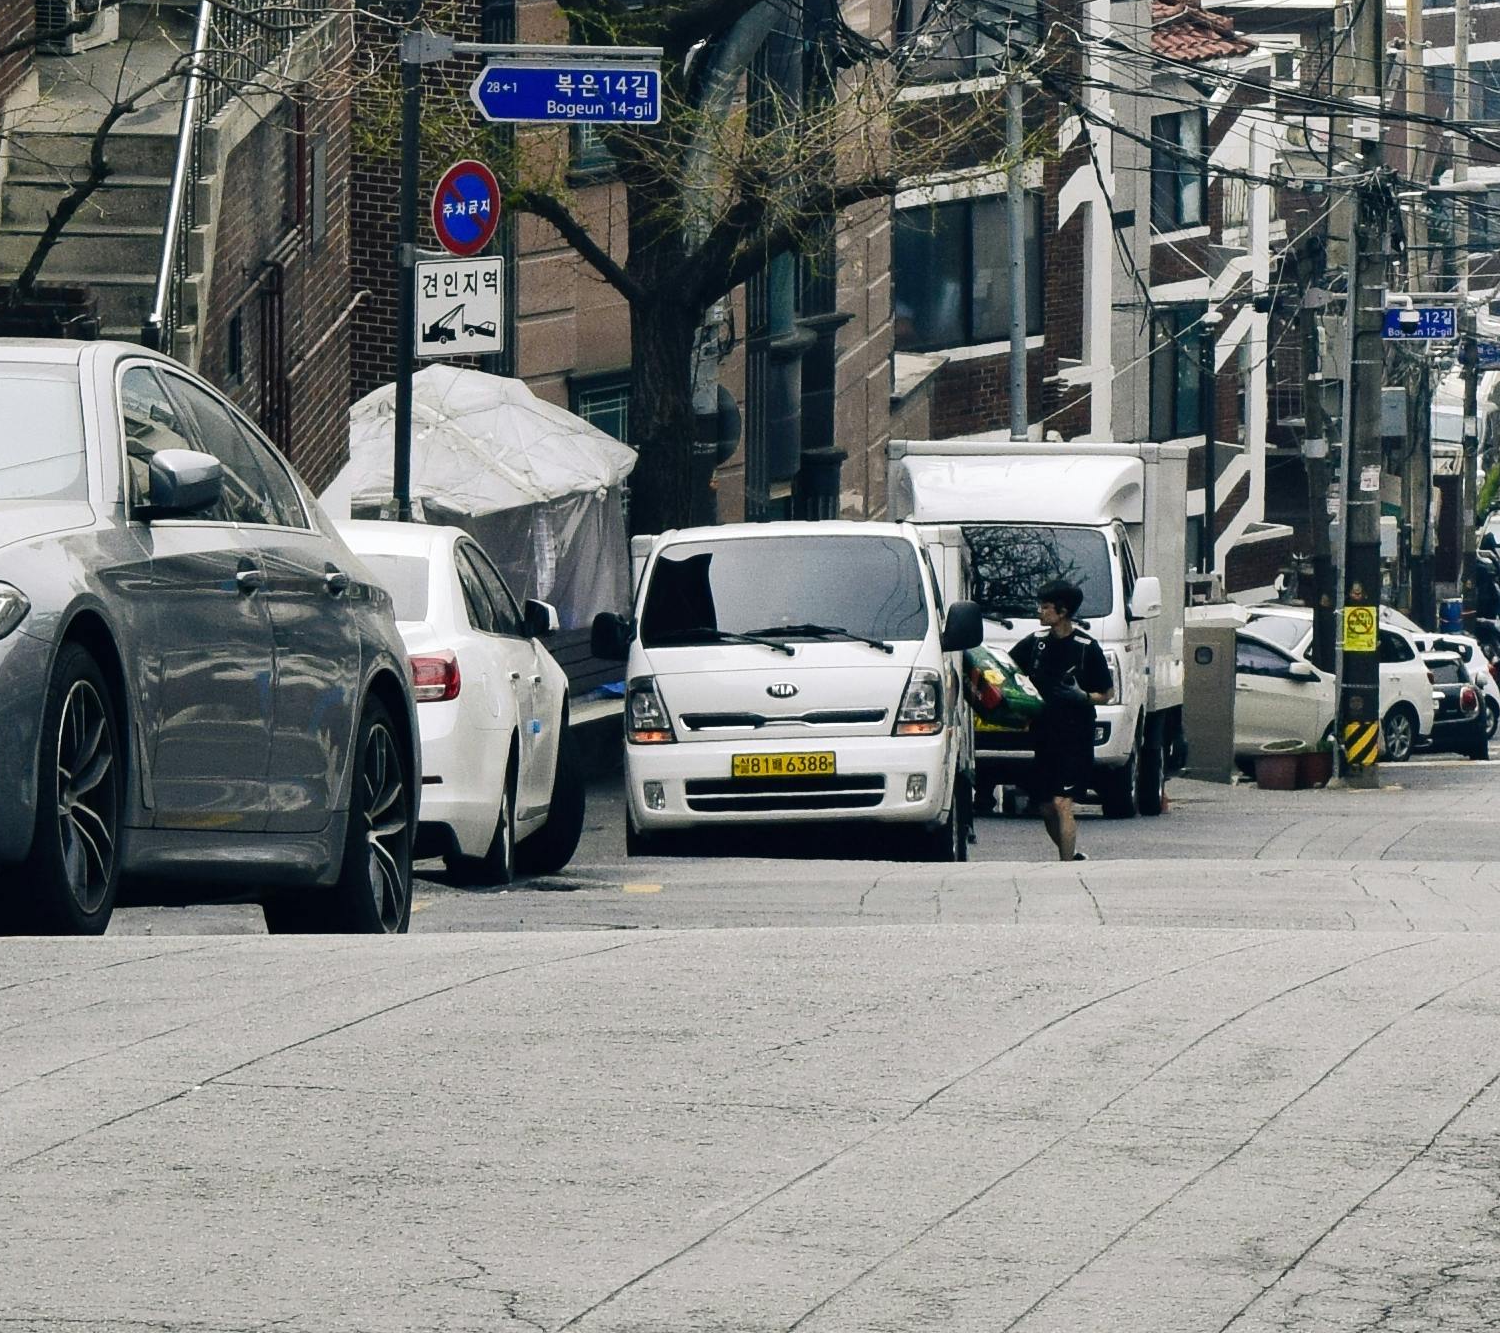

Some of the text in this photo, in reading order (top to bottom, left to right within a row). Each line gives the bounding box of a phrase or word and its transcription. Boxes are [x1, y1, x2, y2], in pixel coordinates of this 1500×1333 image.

[486, 82, 500, 93] 28
[555, 73, 649, 99] 복은14길
[547, 100, 652, 119] Bogeun 14-gil
[443, 198, 491, 220] 주차금지
[422, 269, 498, 299] 견인지역
[772, 684, 794, 695] KIA
[786, 755, 828, 773] 6388
